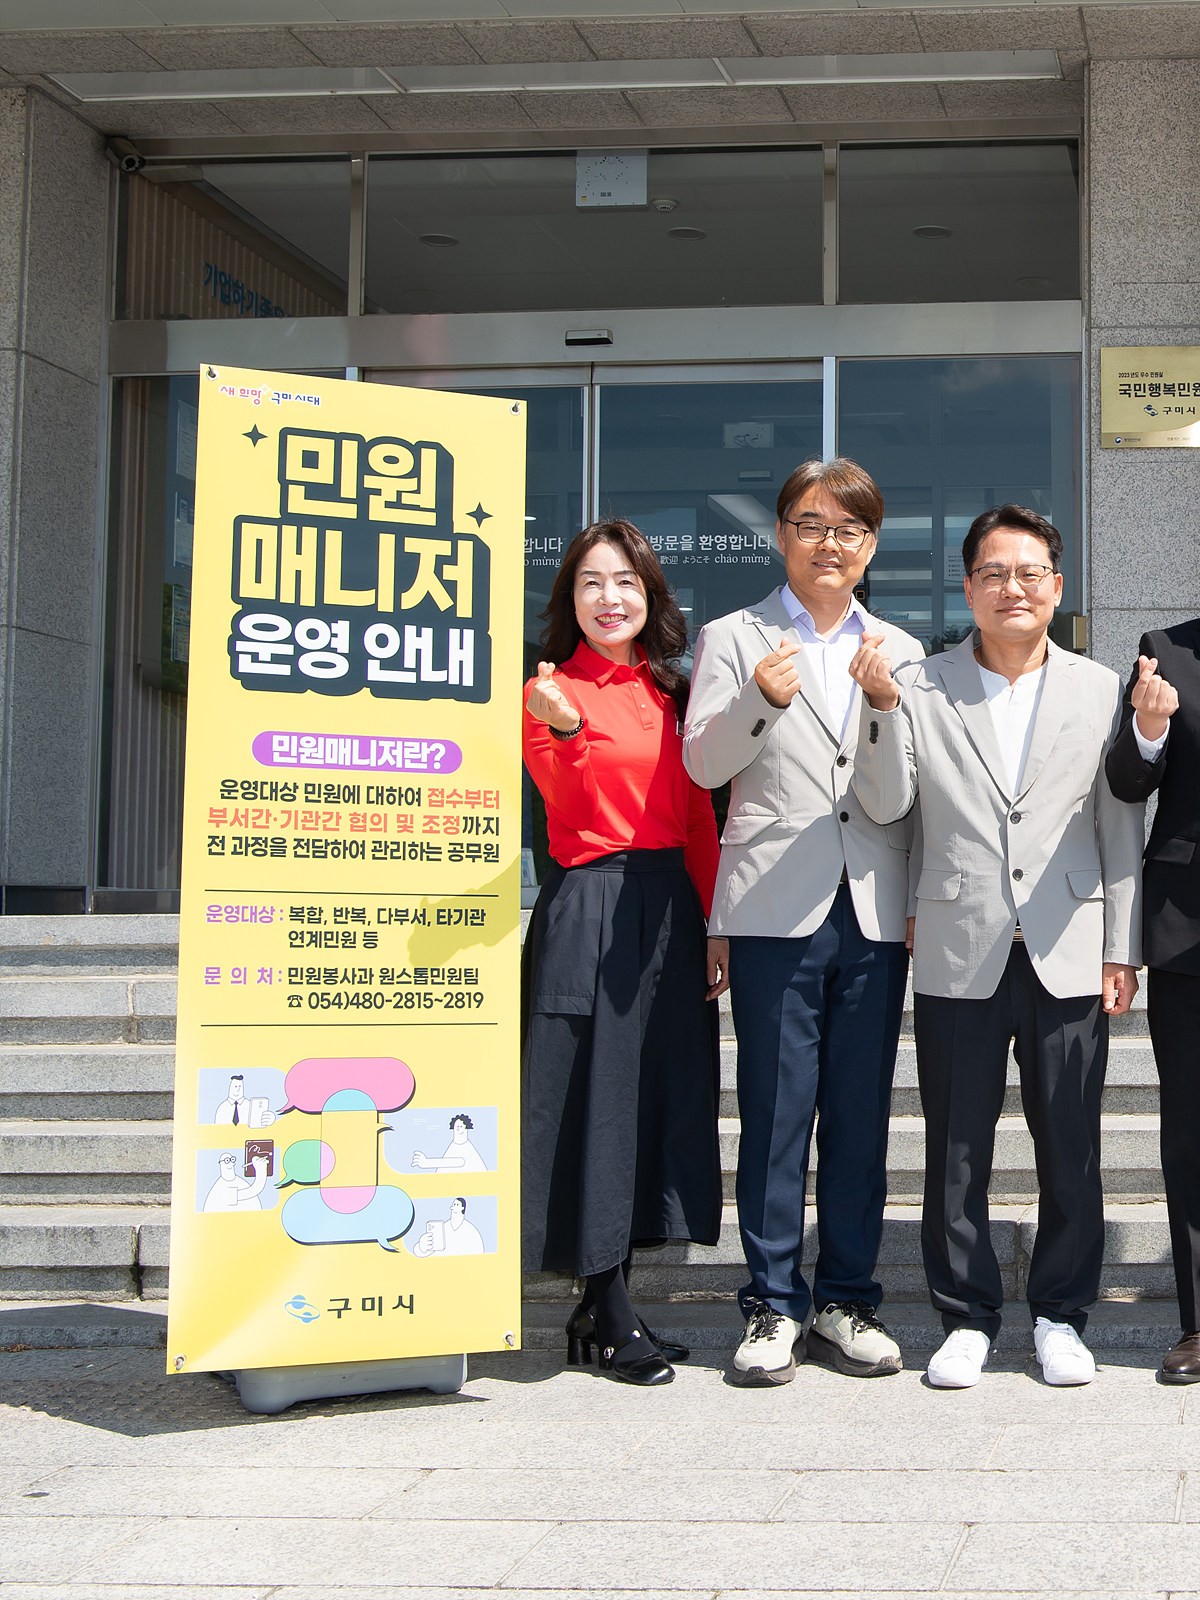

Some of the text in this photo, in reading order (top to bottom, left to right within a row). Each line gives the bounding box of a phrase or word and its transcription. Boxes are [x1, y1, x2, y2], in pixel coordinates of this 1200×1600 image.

[220, 386, 235, 396] 새
[239, 388, 262, 405] 희망
[1162, 406, 1196, 415] 구미시
[285, 434, 437, 526] 민원
[698, 534, 772, 551] 환영합니다
[239, 522, 474, 618] 매니저
[682, 555, 710, 564] ようこそ
[235, 613, 351, 679] 운영
[363, 623, 475, 687] 안내
[272, 734, 446, 770] 민원매니저란?
[220, 779, 500, 810] 운영대상 민원에 대하여 접수부터
[207, 806, 500, 836] 부서간·기관간 협의 및 조정까지
[207, 835, 500, 863] 전 과정을 전담하여 관리하는 공무원
[288, 906, 327, 926] 복합,
[333, 907, 371, 927] 반복,
[376, 907, 432, 927] 다부서,
[436, 908, 487, 927] 타기관
[288, 930, 379, 949] 연계민원 등
[287, 967, 374, 986] 민원봉사과
[378, 967, 479, 986] 원스톱민원팀
[307, 991, 484, 1010] 054)480-2815~2819
[326, 1294, 415, 1319] 구미시
